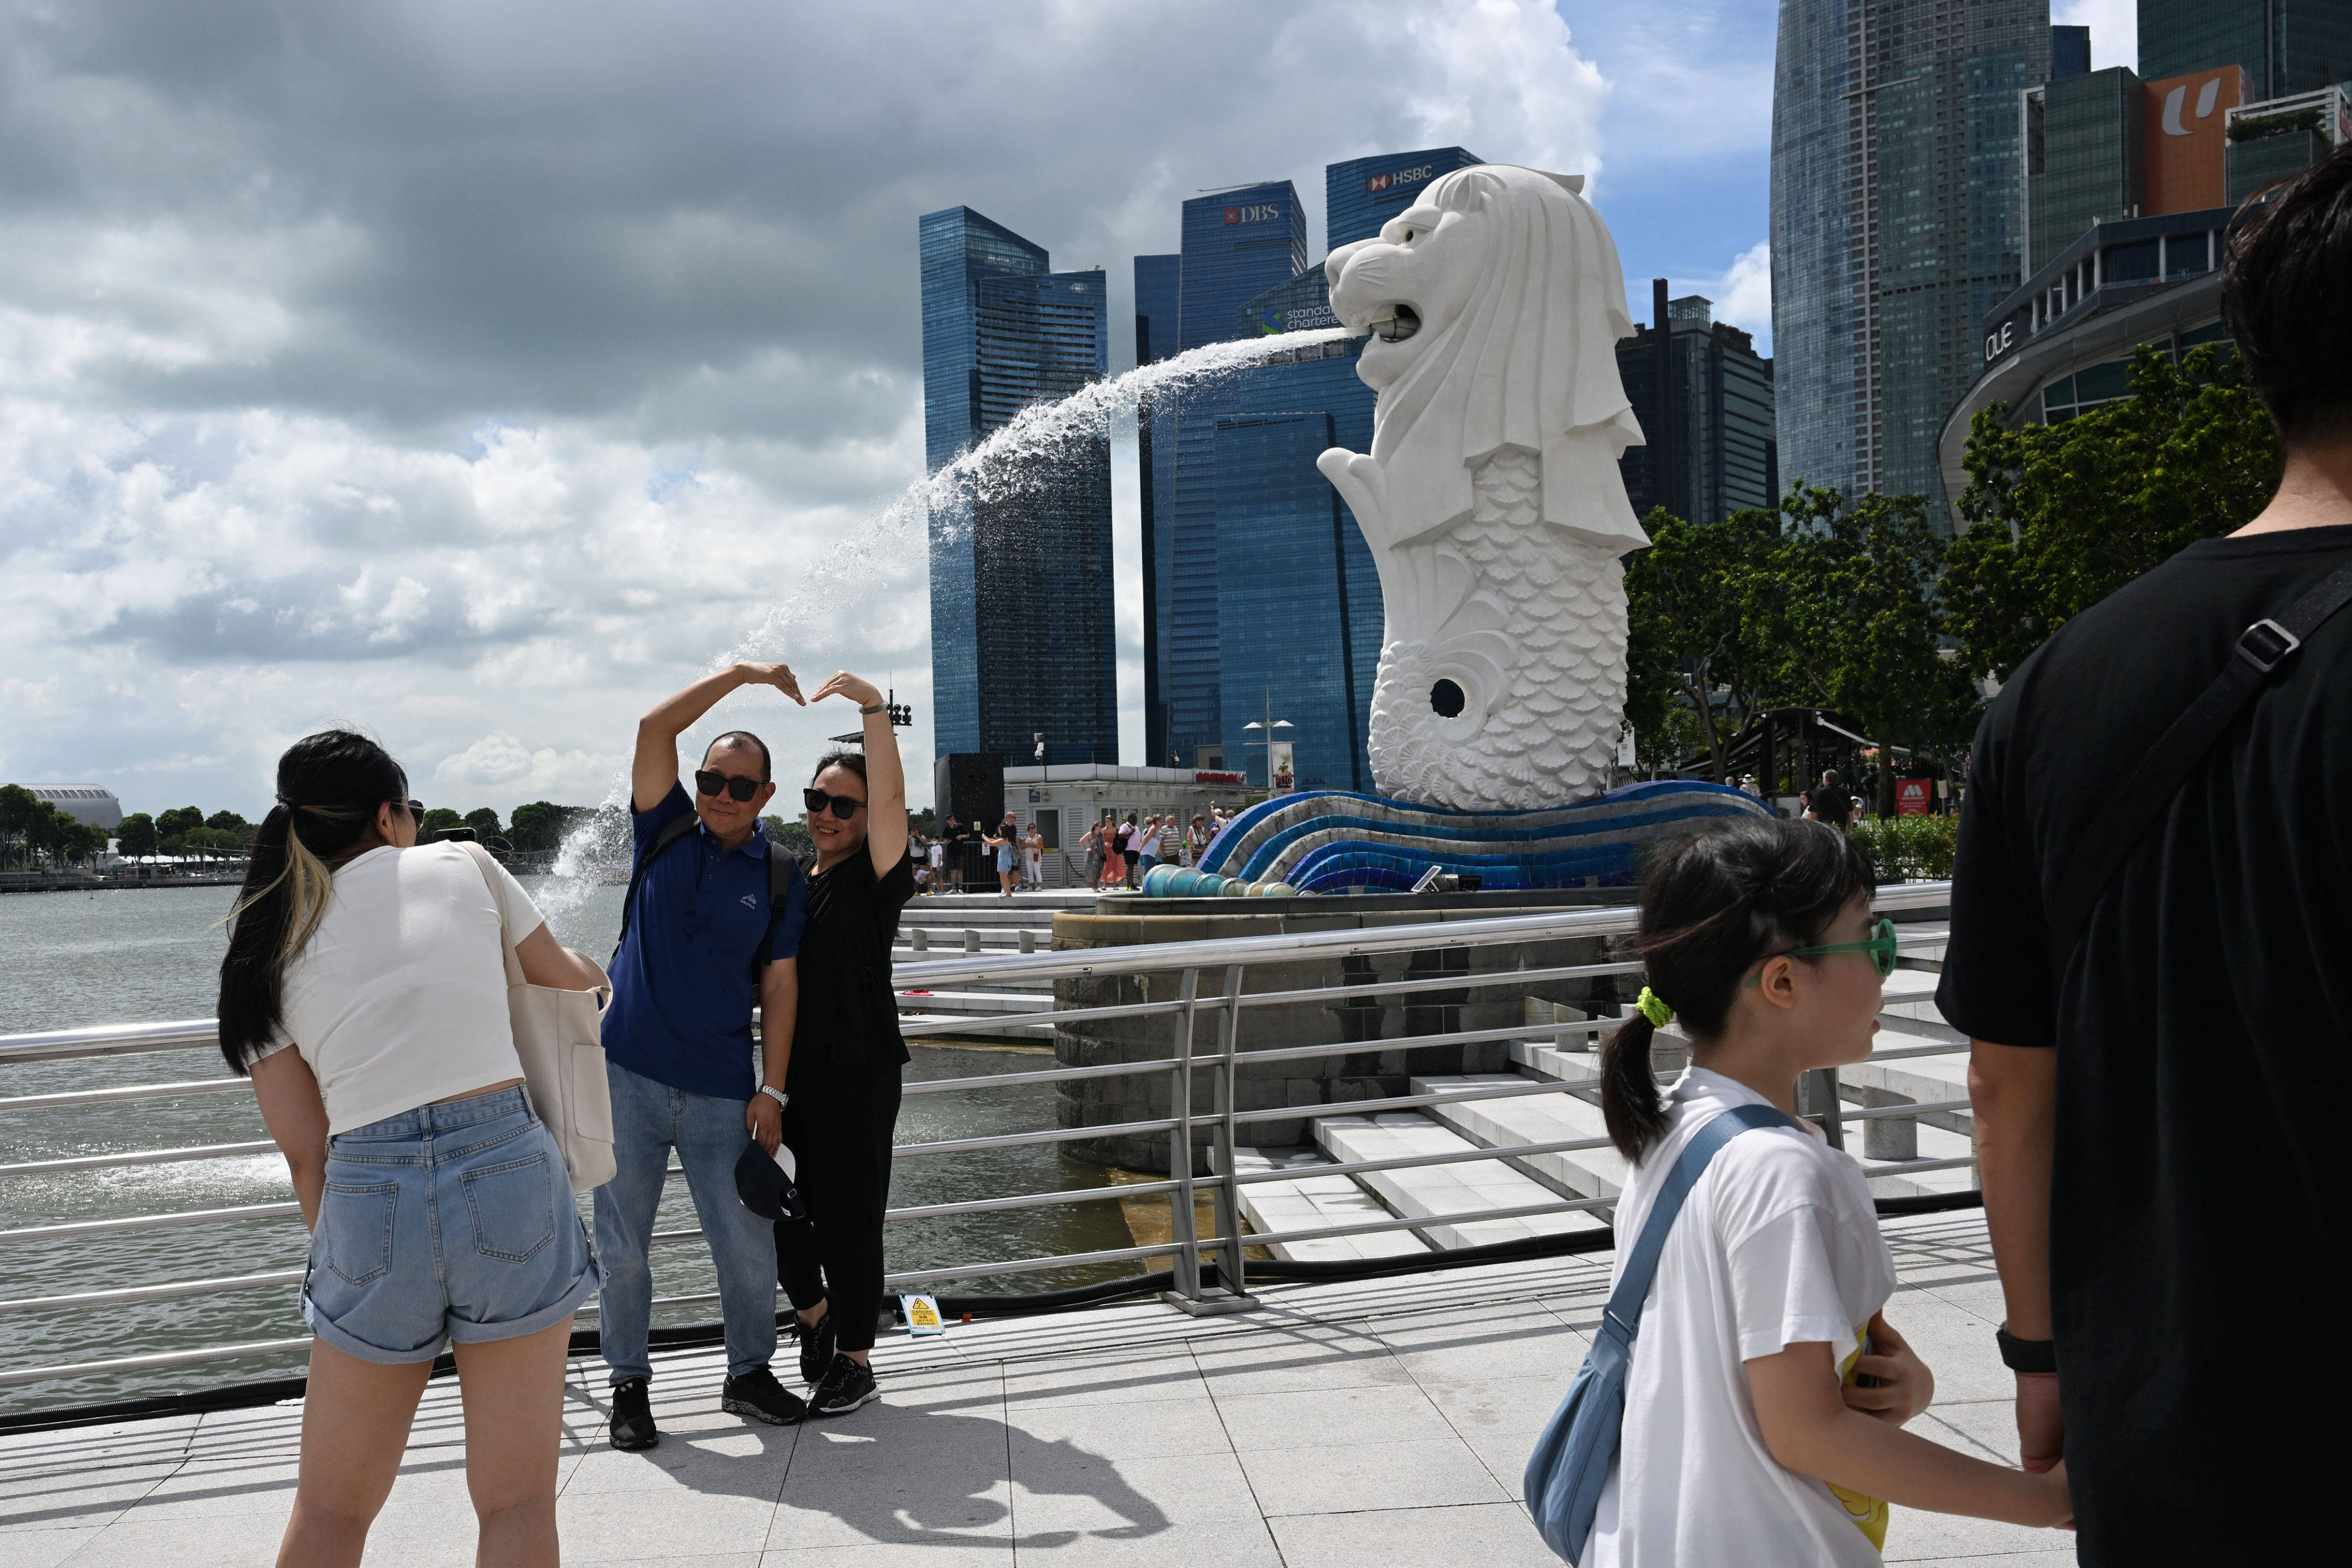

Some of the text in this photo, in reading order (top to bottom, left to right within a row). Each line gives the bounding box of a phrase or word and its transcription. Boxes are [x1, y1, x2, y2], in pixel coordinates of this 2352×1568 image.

[1393, 165, 1432, 186] HSBC
[1241, 203, 1279, 223] DBS
[740, 899, 755, 909] NAUTICA
